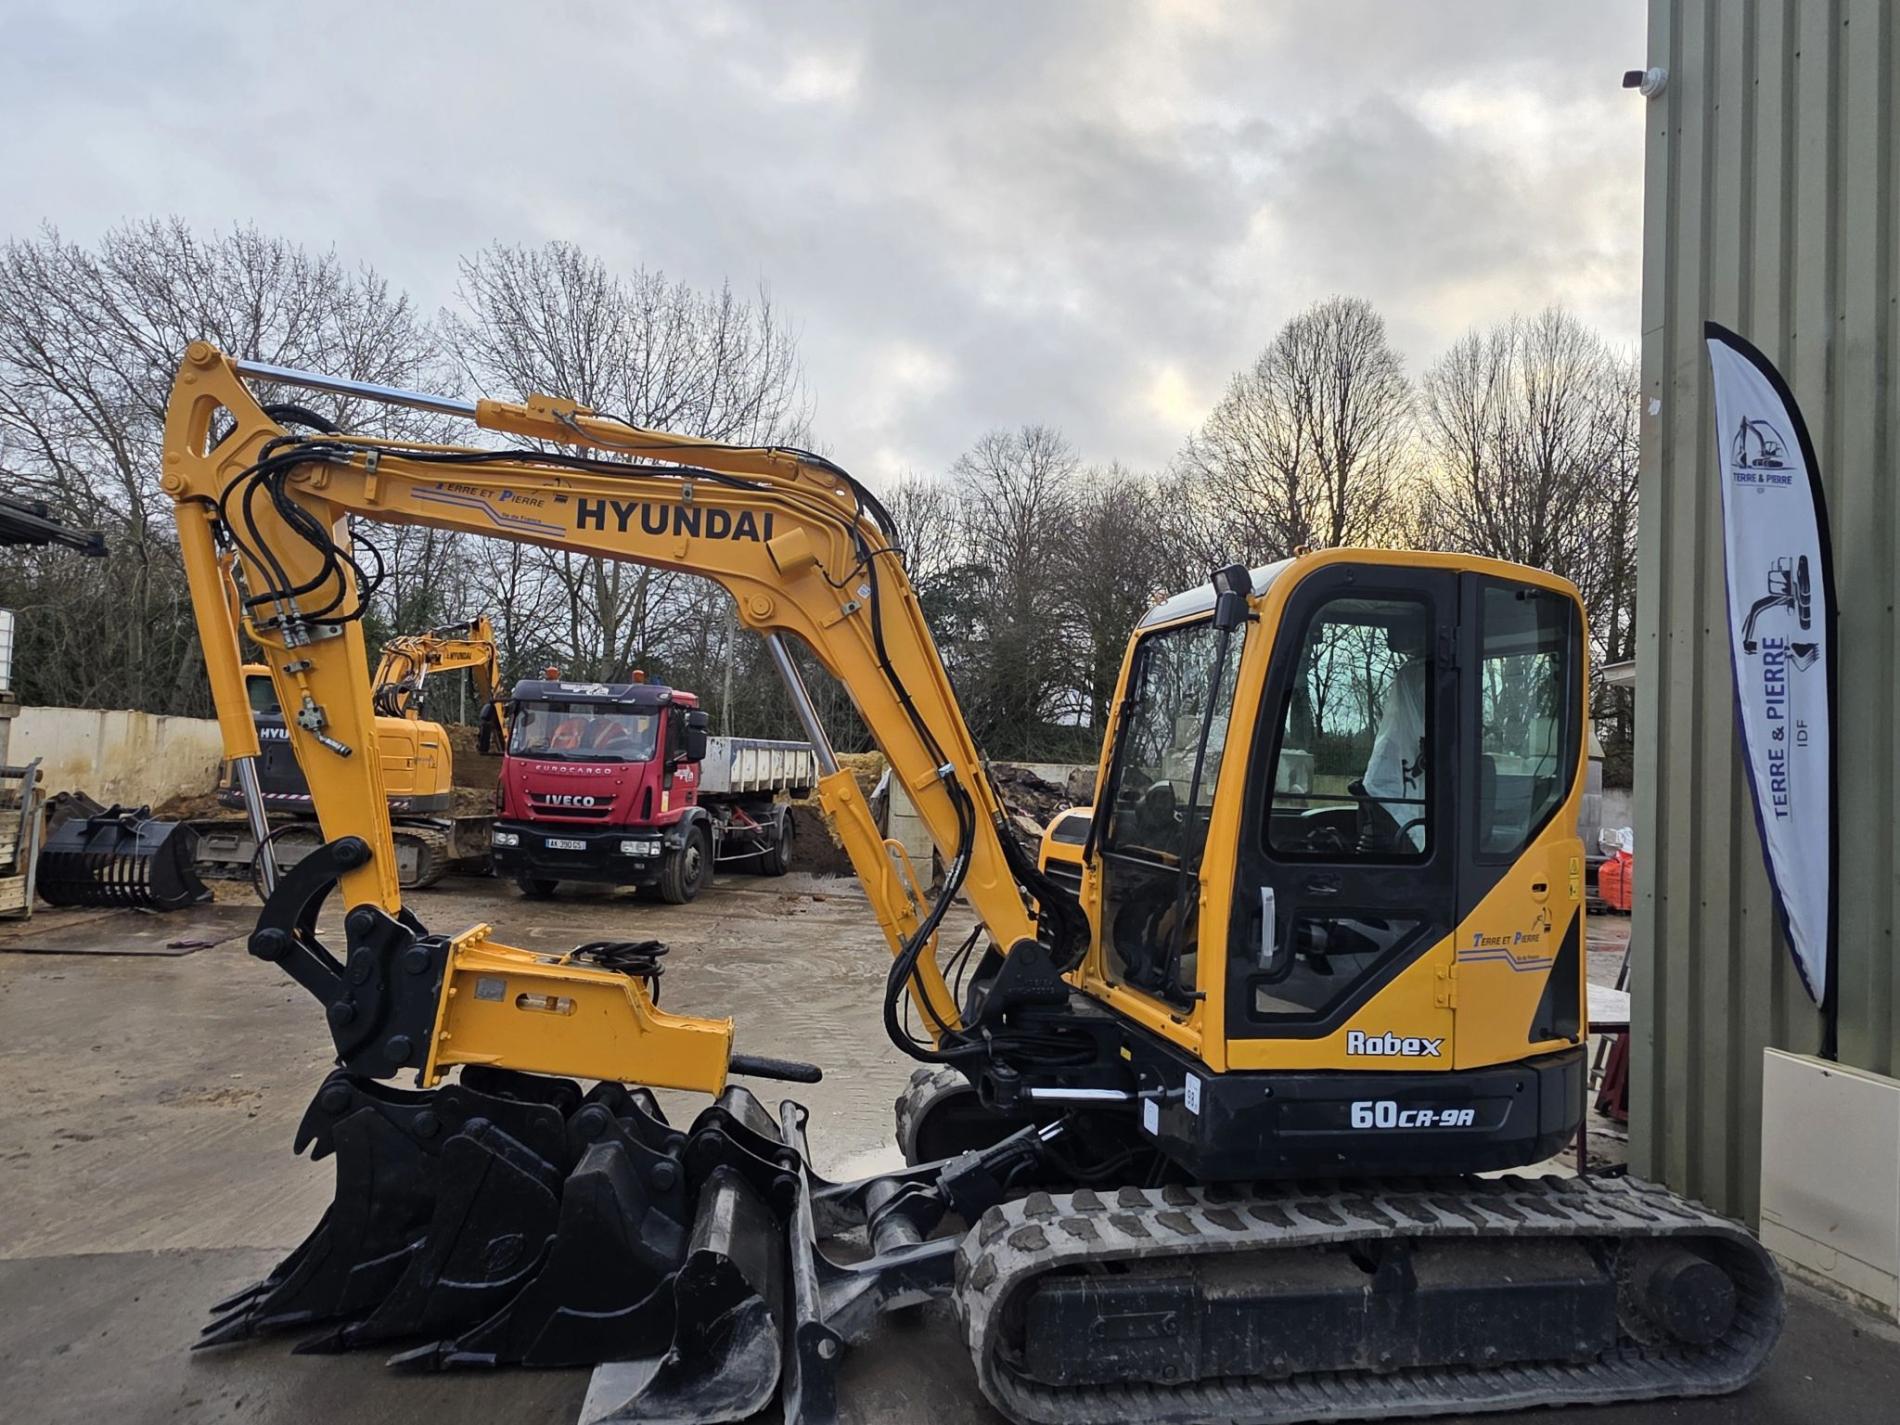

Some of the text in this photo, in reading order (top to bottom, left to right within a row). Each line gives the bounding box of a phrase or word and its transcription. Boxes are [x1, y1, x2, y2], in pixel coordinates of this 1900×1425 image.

[1733, 472, 1793, 486] TERRE & PIERRE
[480, 489, 495, 498] ET
[498, 489, 546, 507] PIERRE
[576, 498, 775, 543] HYUNDAI
[1763, 637, 1789, 821] TERRE & PIERRE
[1796, 719, 1809, 748] IDF
[535, 764, 612, 775] EUROCARGO
[545, 794, 595, 807] IVECO
[1473, 931, 1540, 947] TERRE ET PIERRE
[1346, 1030, 1445, 1057] Robex
[1351, 1100, 1476, 1129] 60CR-9A
